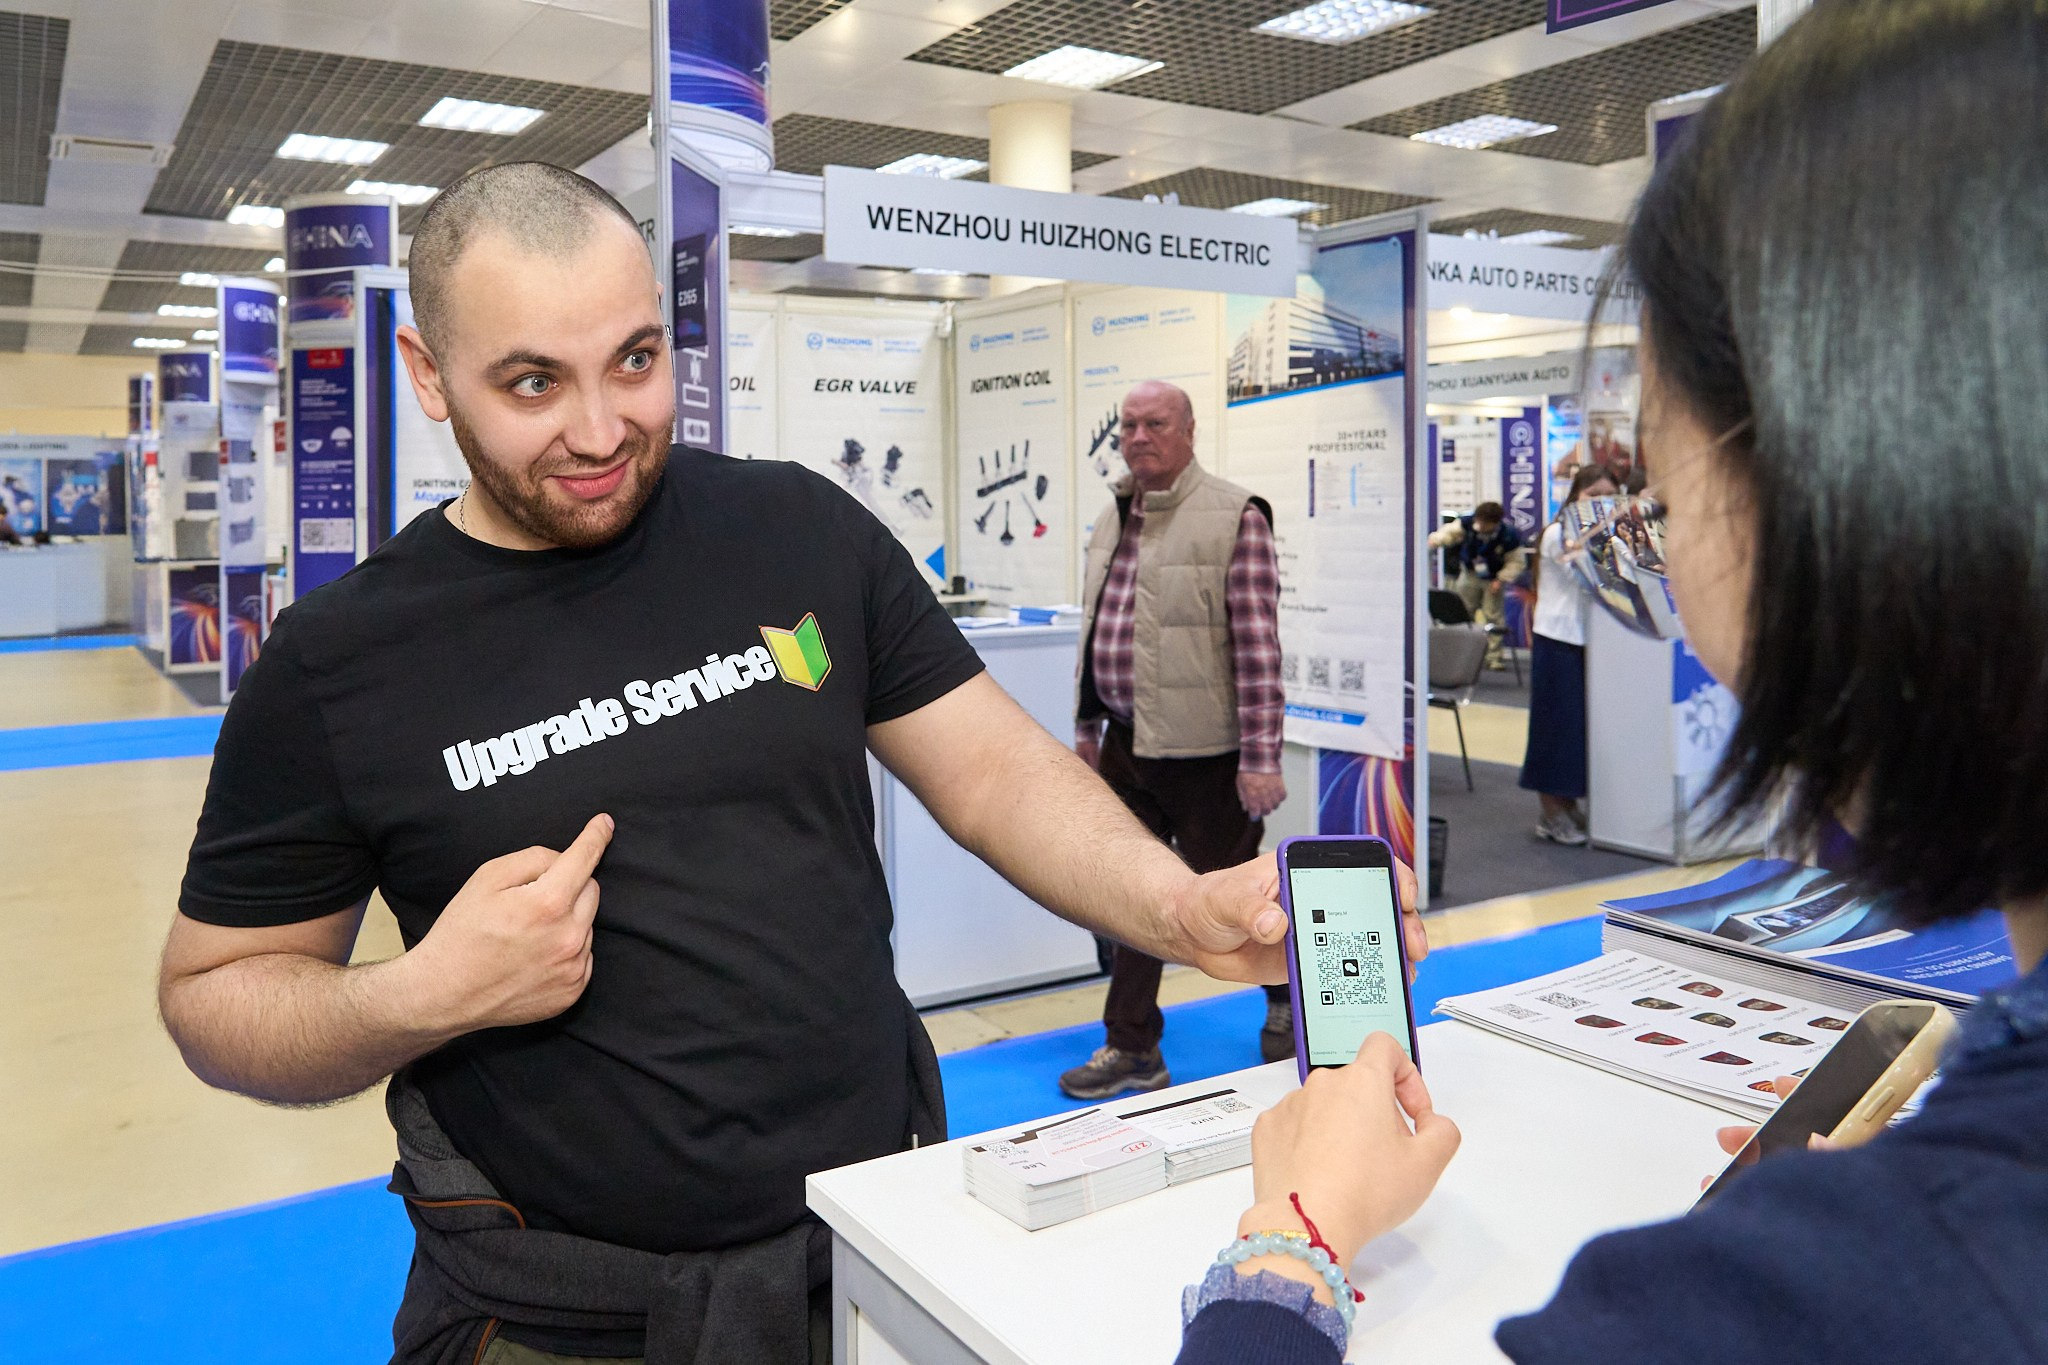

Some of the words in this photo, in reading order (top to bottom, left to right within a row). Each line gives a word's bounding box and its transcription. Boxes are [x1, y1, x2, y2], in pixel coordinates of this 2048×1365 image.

[867, 204, 1010, 242] WENZHOU
[1020, 219, 1152, 256] HUIZHONG
[1160, 234, 1271, 267] ELECTRIC
[1469, 265, 1519, 289] AUTO
[1523, 271, 1579, 295] PARTS
[730, 376, 757, 392] OIL
[814, 378, 854, 393] EGR
[859, 381, 917, 395] VALVE
[970, 373, 1022, 395] IGNITION
[1024, 369, 1053, 388] COIL
[1509, 420, 1535, 531] CHINA
[442, 697, 630, 792] Upgrade
[623, 645, 777, 726] Service
[1190, 1114, 1223, 1126] Laura
[1127, 1141, 1149, 1153] ZFT
